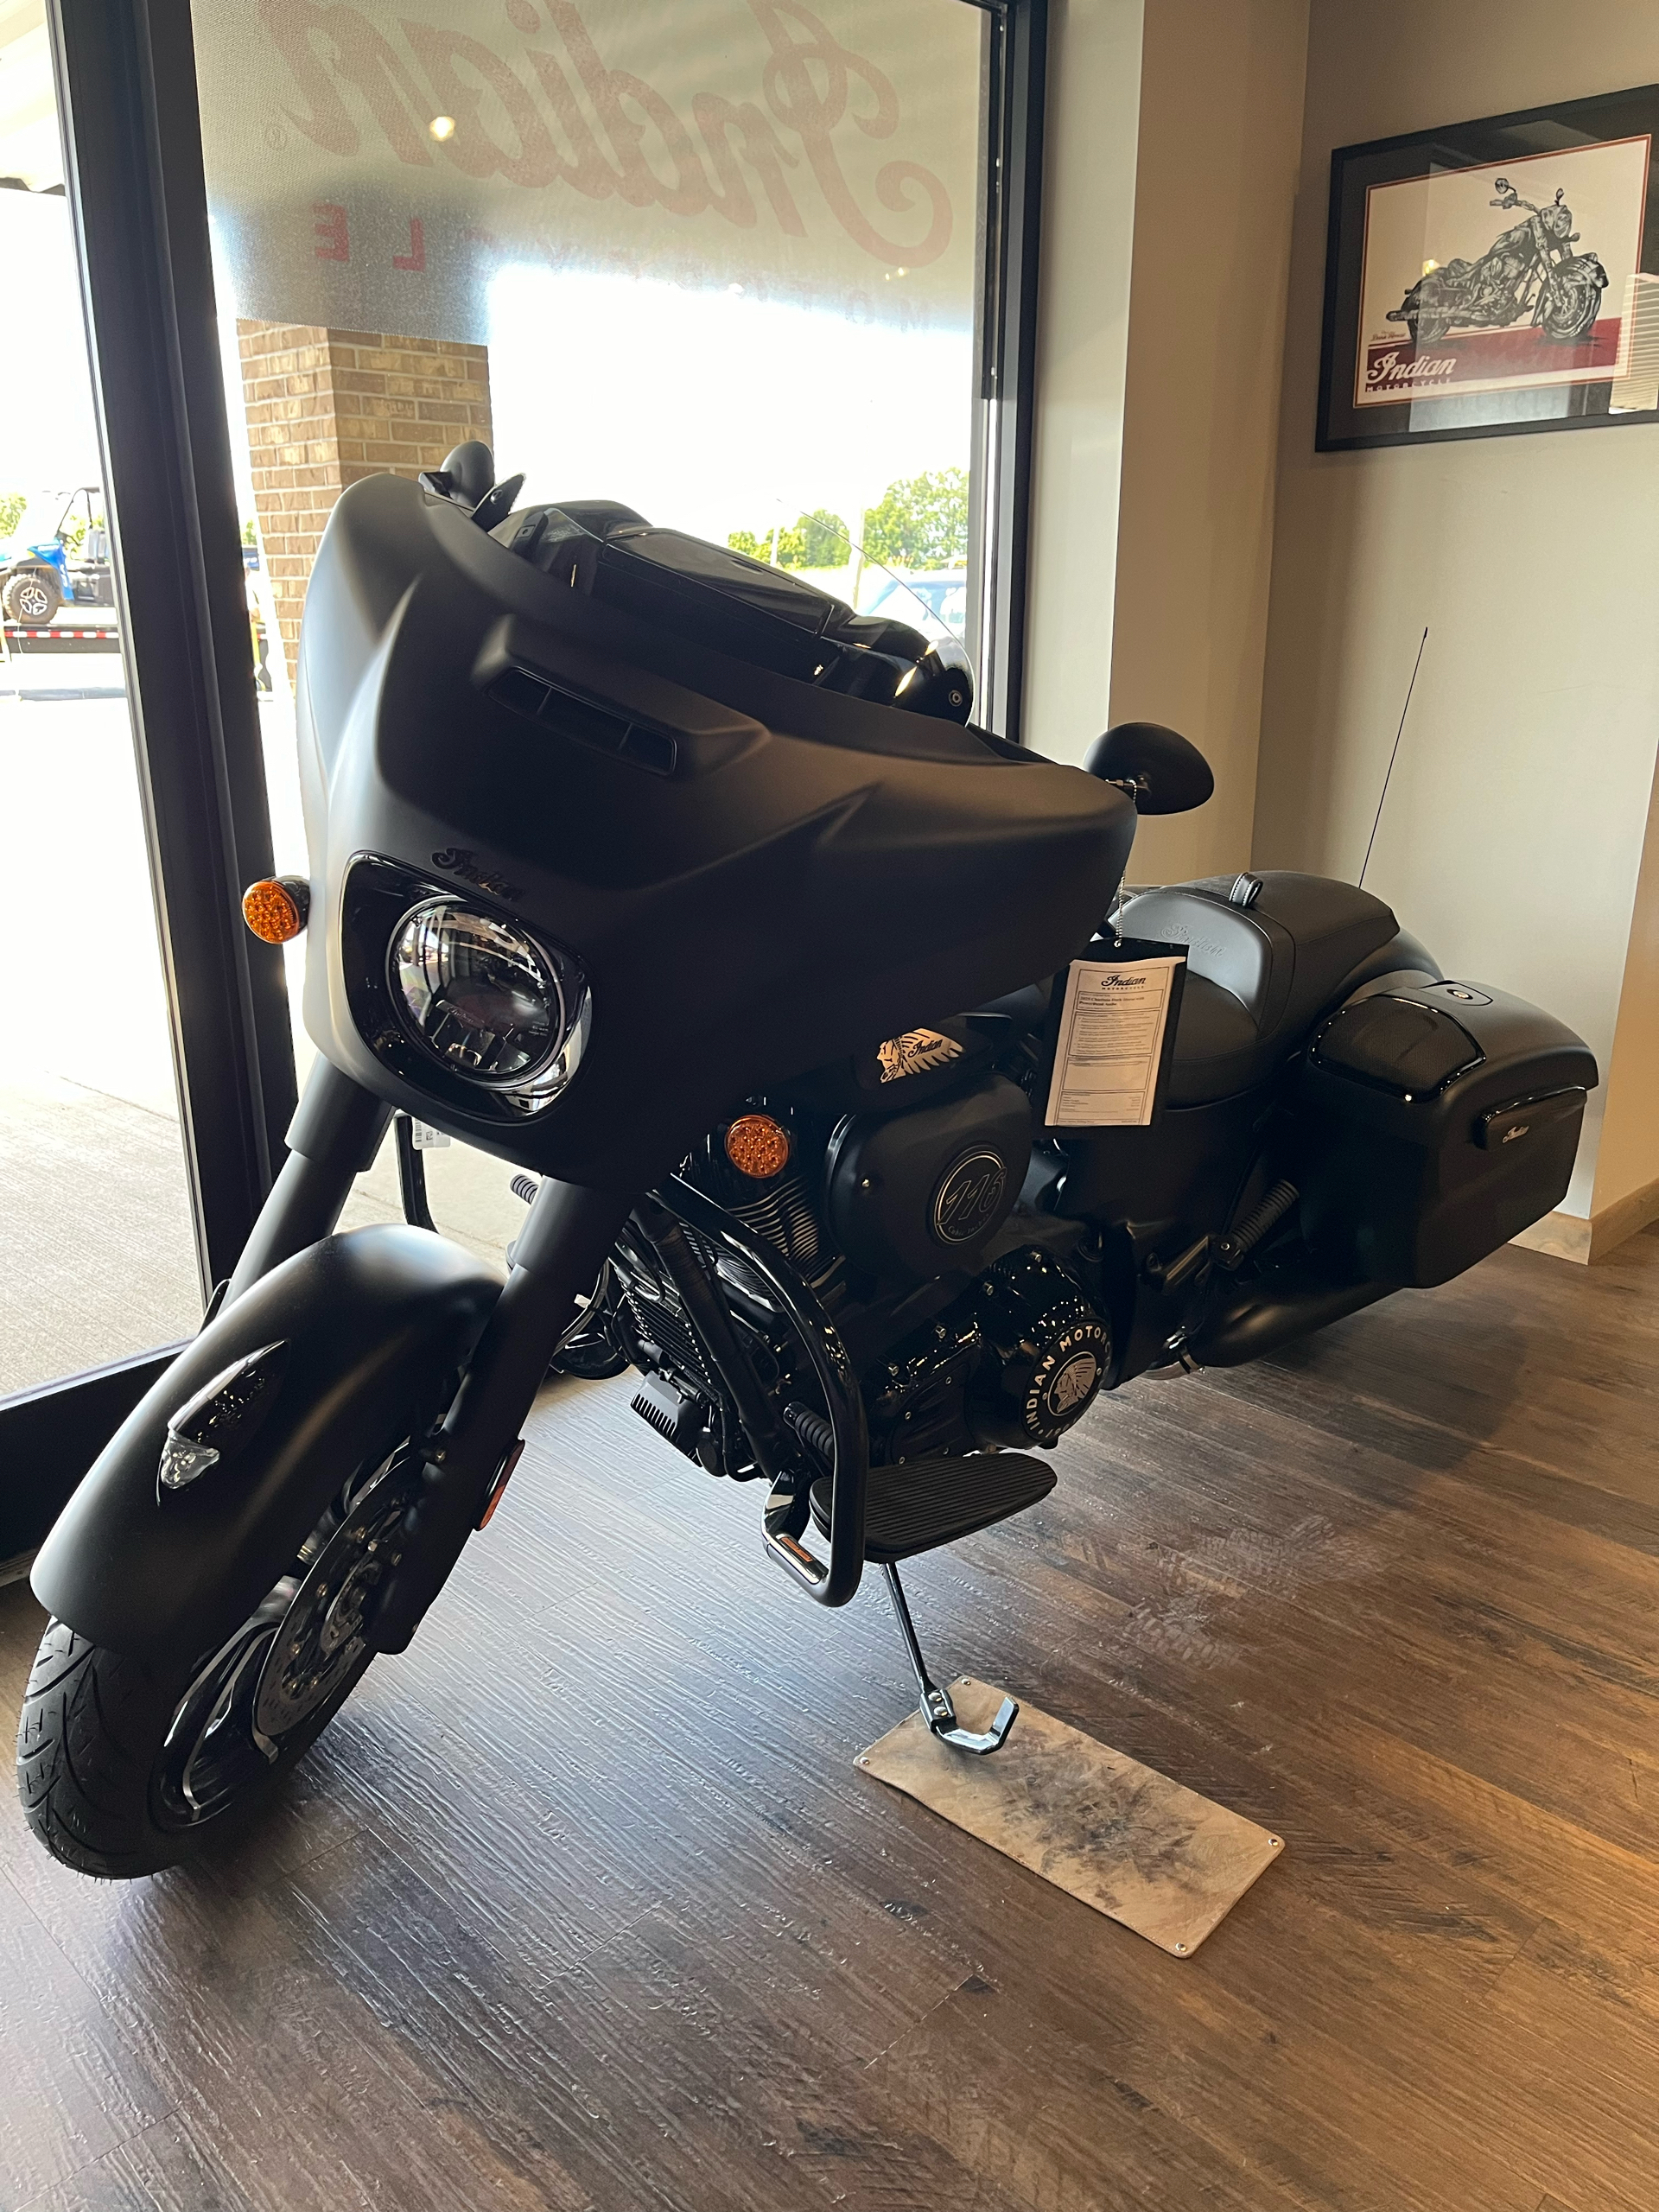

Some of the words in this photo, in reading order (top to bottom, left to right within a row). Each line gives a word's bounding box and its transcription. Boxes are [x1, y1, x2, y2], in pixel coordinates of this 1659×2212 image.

[1366, 351, 1457, 385] Indian
[430, 847, 525, 901] Indian
[1101, 974, 1147, 987] Indian
[907, 1039, 944, 1058] Indian
[935, 1166, 1008, 1226] 116
[1026, 1354, 1056, 1431] INDIAN
